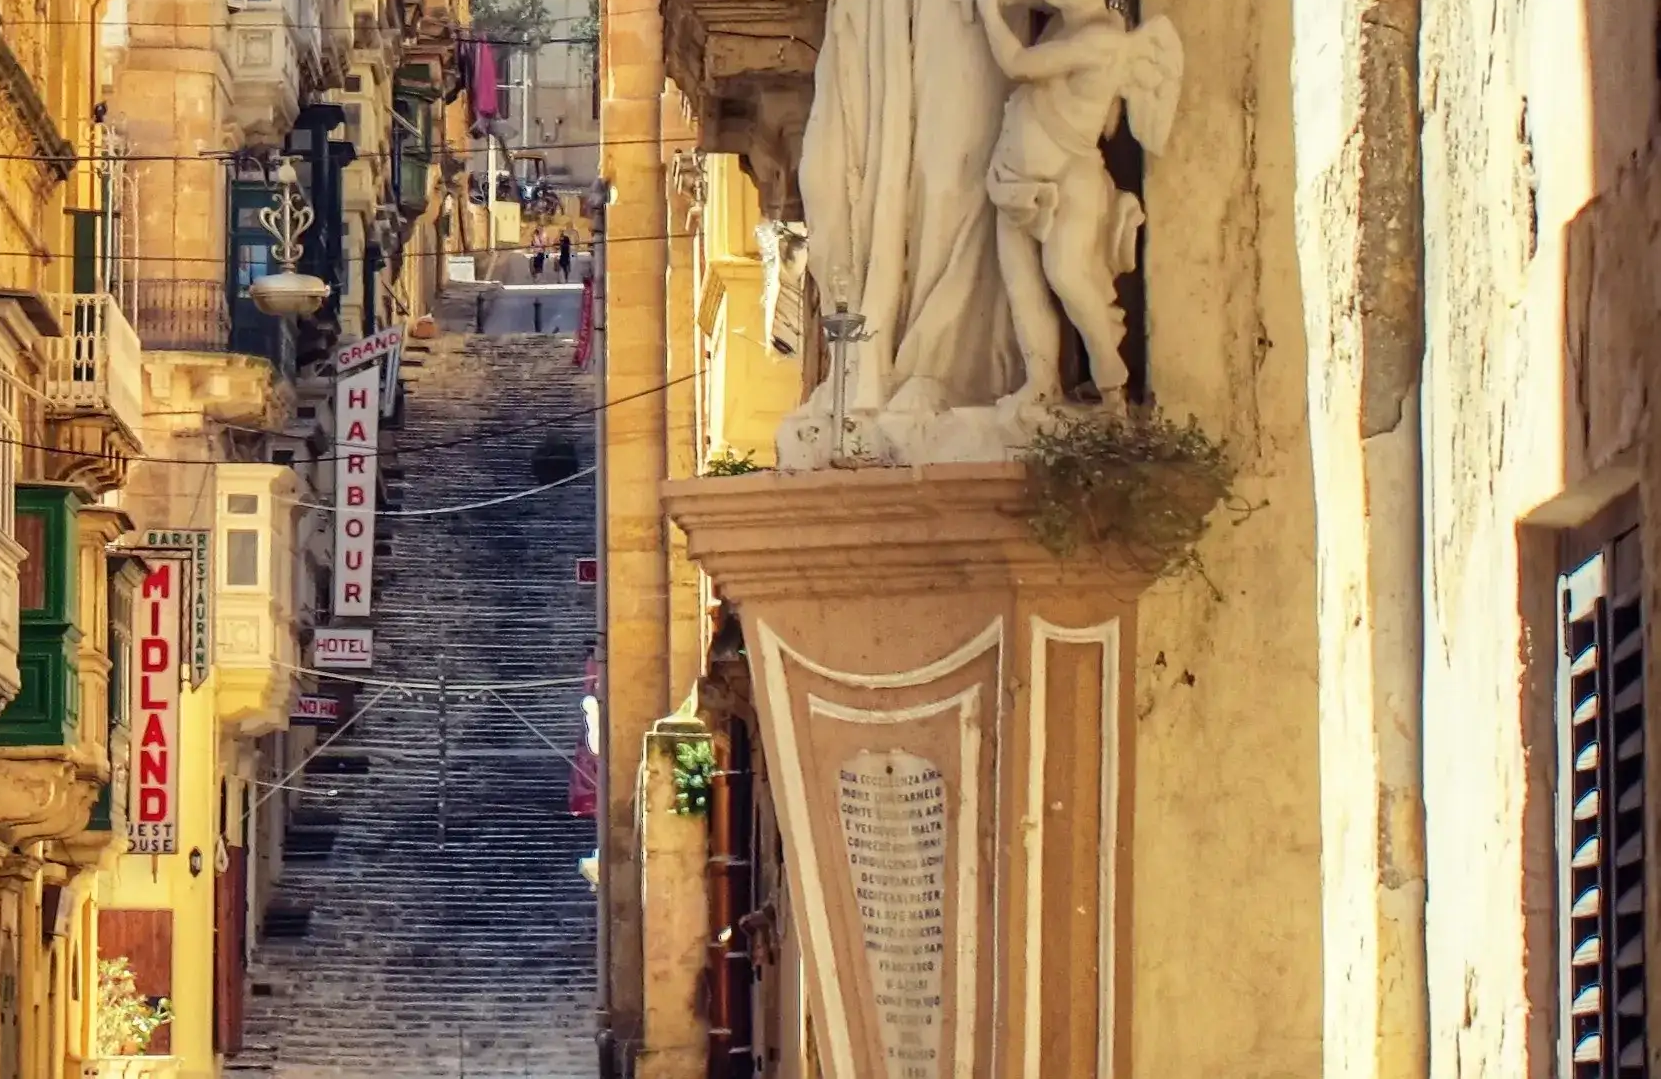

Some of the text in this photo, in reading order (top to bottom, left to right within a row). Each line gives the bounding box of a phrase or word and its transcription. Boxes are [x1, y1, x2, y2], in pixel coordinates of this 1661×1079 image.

[339, 333, 400, 365] GRAND
[344, 388, 368, 603] HARBOUR
[195, 534, 207, 679] RESTAURANT
[316, 638, 370, 654] HOTEL
[139, 564, 170, 822] MIDLAND
[127, 823, 173, 837] UEST
[127, 839, 173, 852] OUSE
